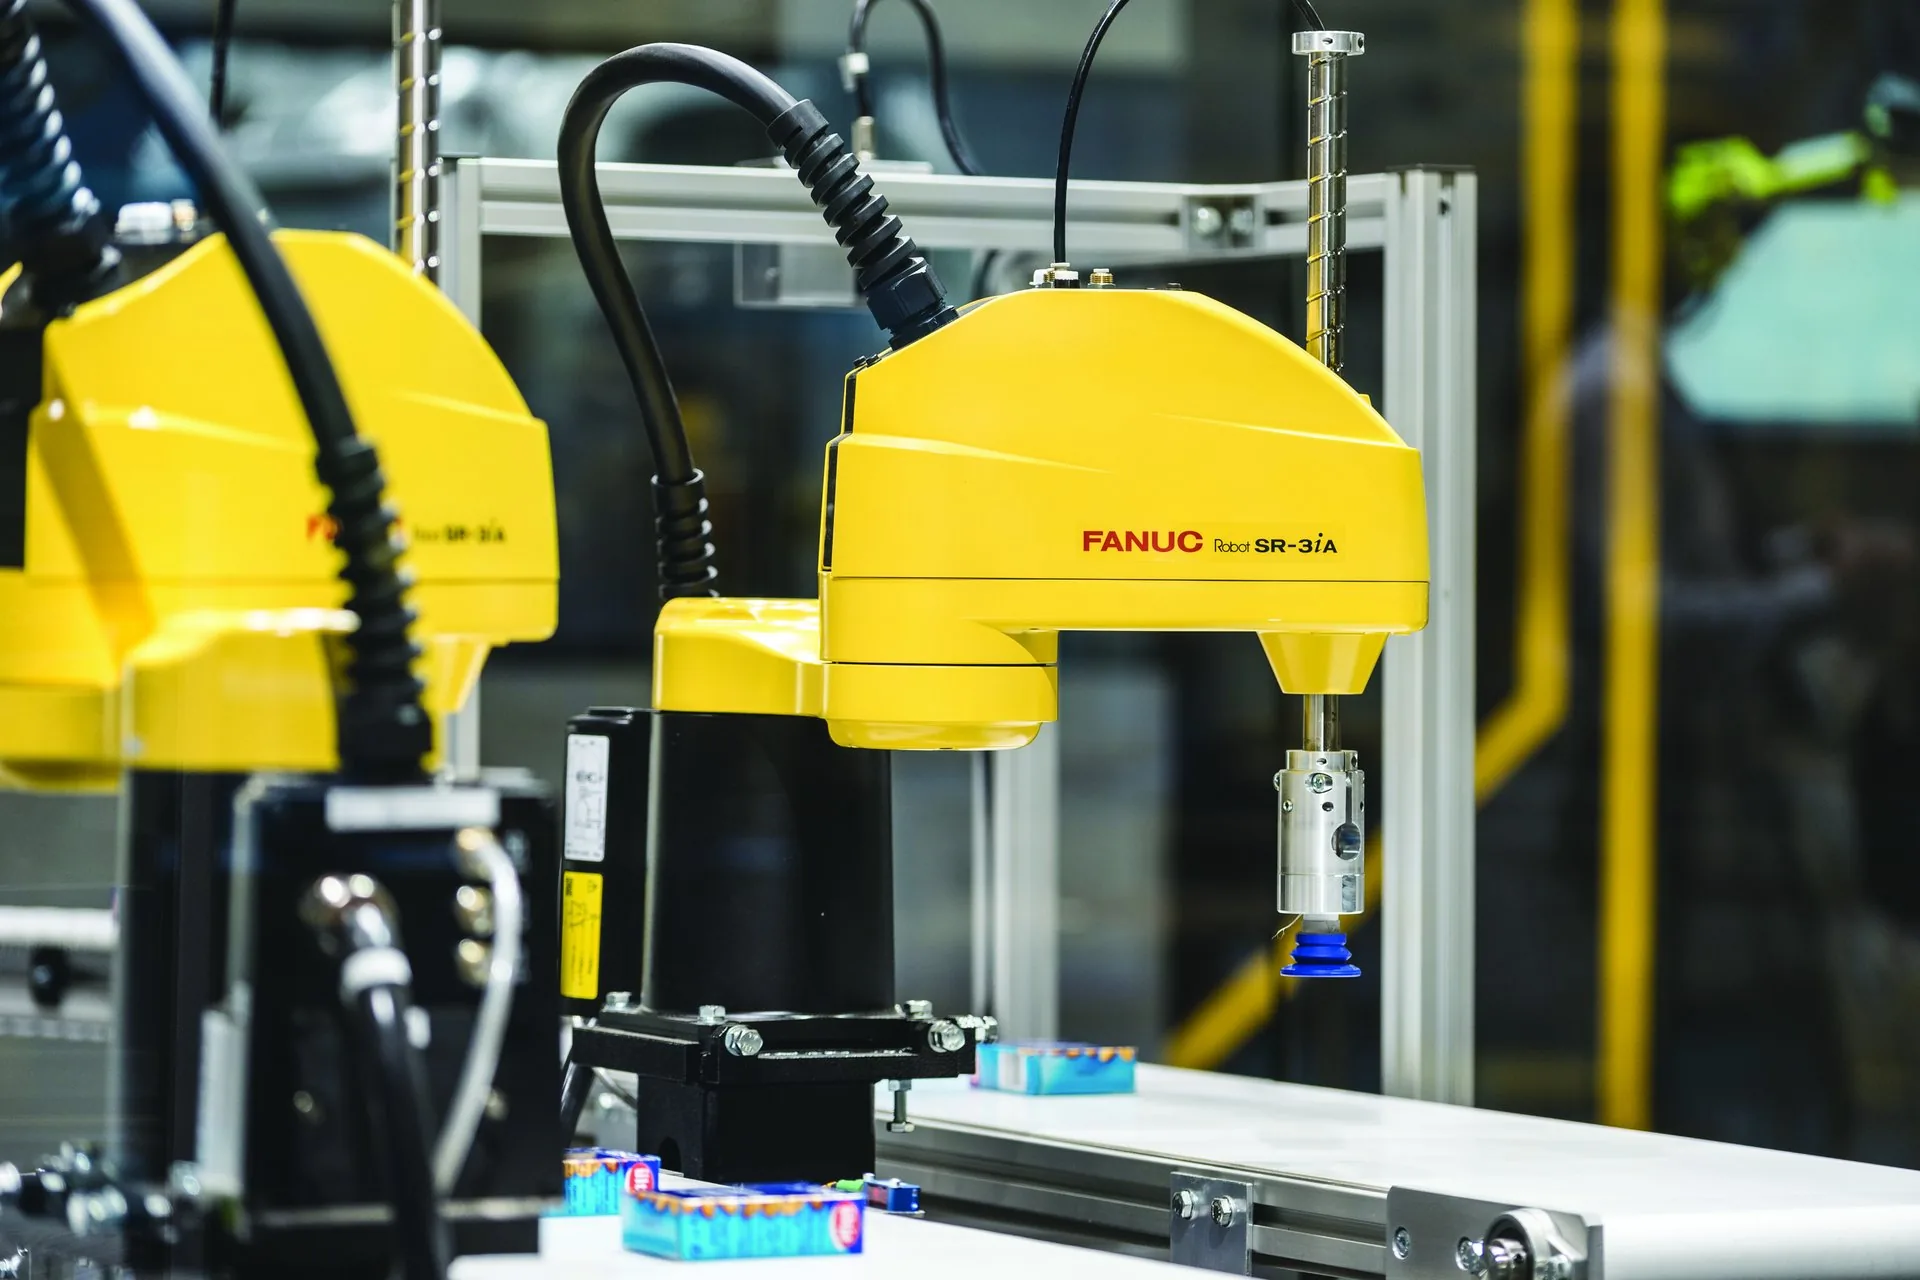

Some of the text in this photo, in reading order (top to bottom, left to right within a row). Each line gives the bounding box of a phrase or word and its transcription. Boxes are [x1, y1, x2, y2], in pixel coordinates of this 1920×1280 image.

[1083, 530, 1338, 553] FANUC Robot SR-3iA
